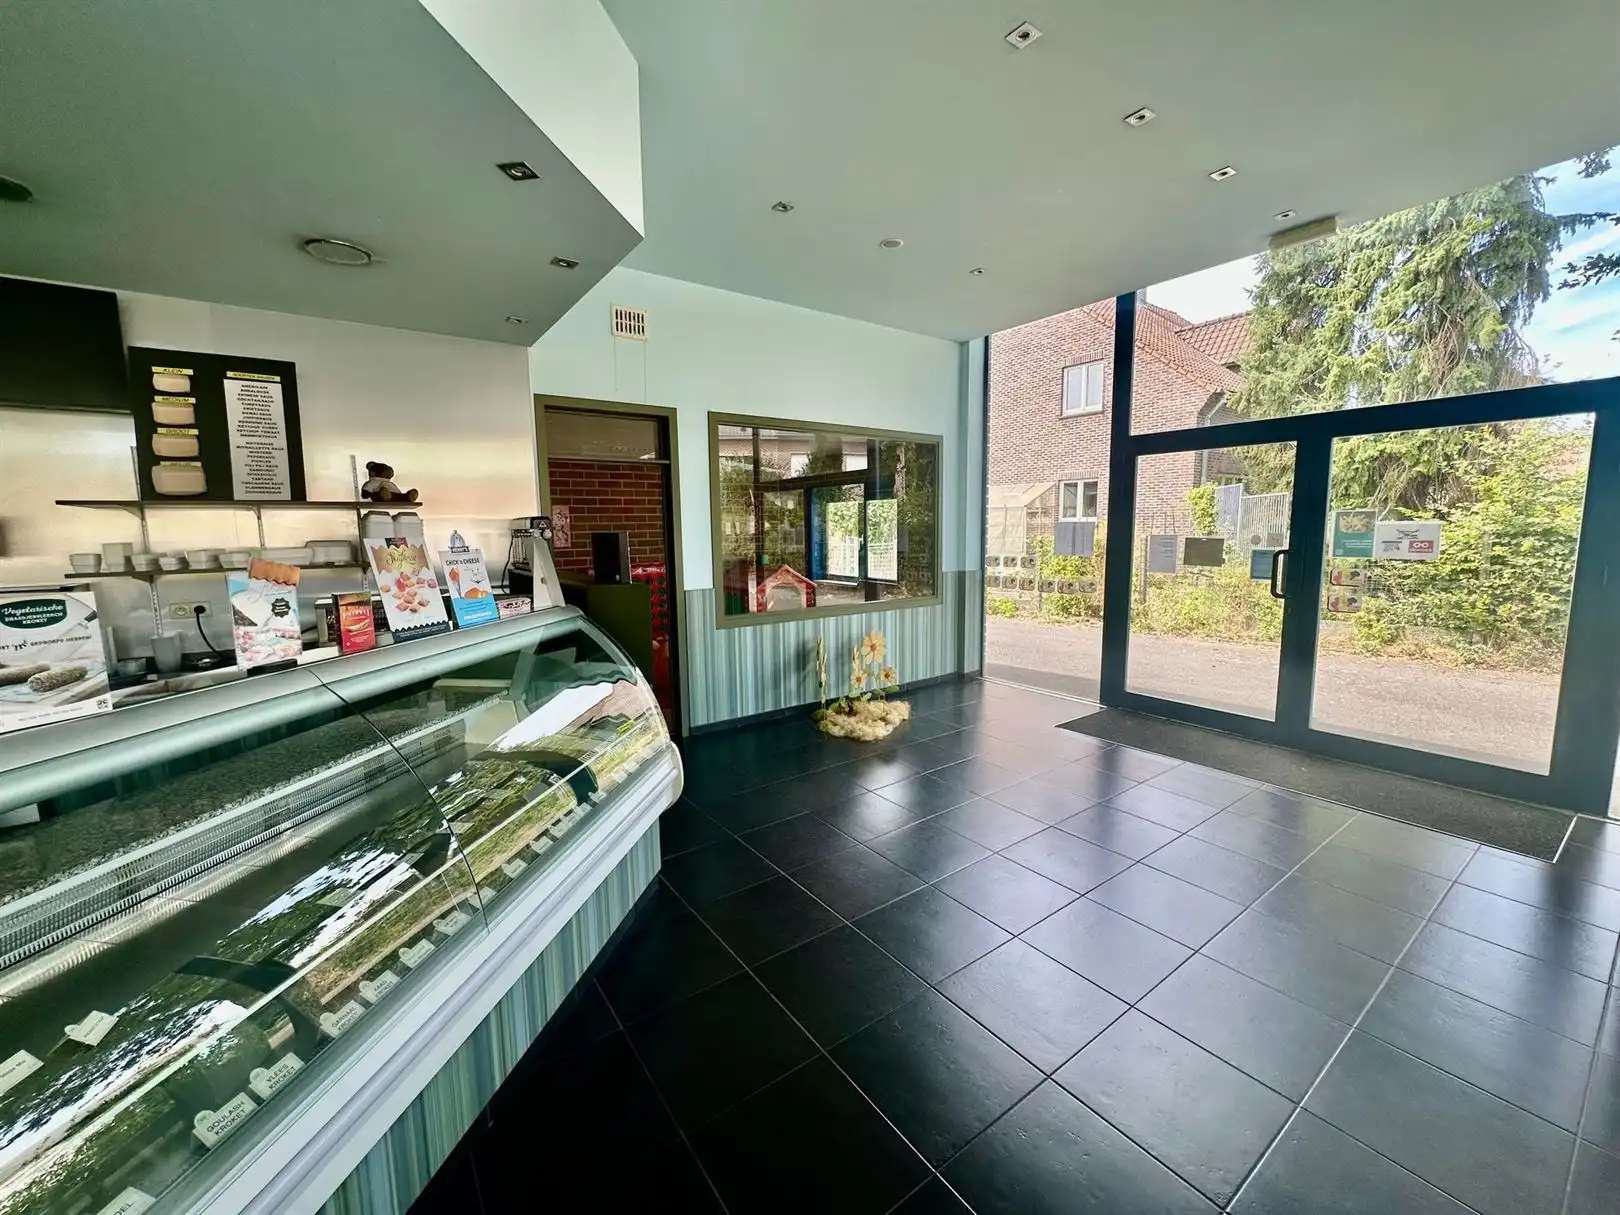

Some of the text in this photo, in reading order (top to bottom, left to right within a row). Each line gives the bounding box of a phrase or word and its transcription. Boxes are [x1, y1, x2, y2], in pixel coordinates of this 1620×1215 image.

[1, 604, 63, 616] Vegetarische
[266, 1063, 289, 1082] VLEES
[269, 1066, 296, 1089] KROKET
[206, 1101, 245, 1132] GOULASH
[214, 1109, 247, 1136] KROKET
